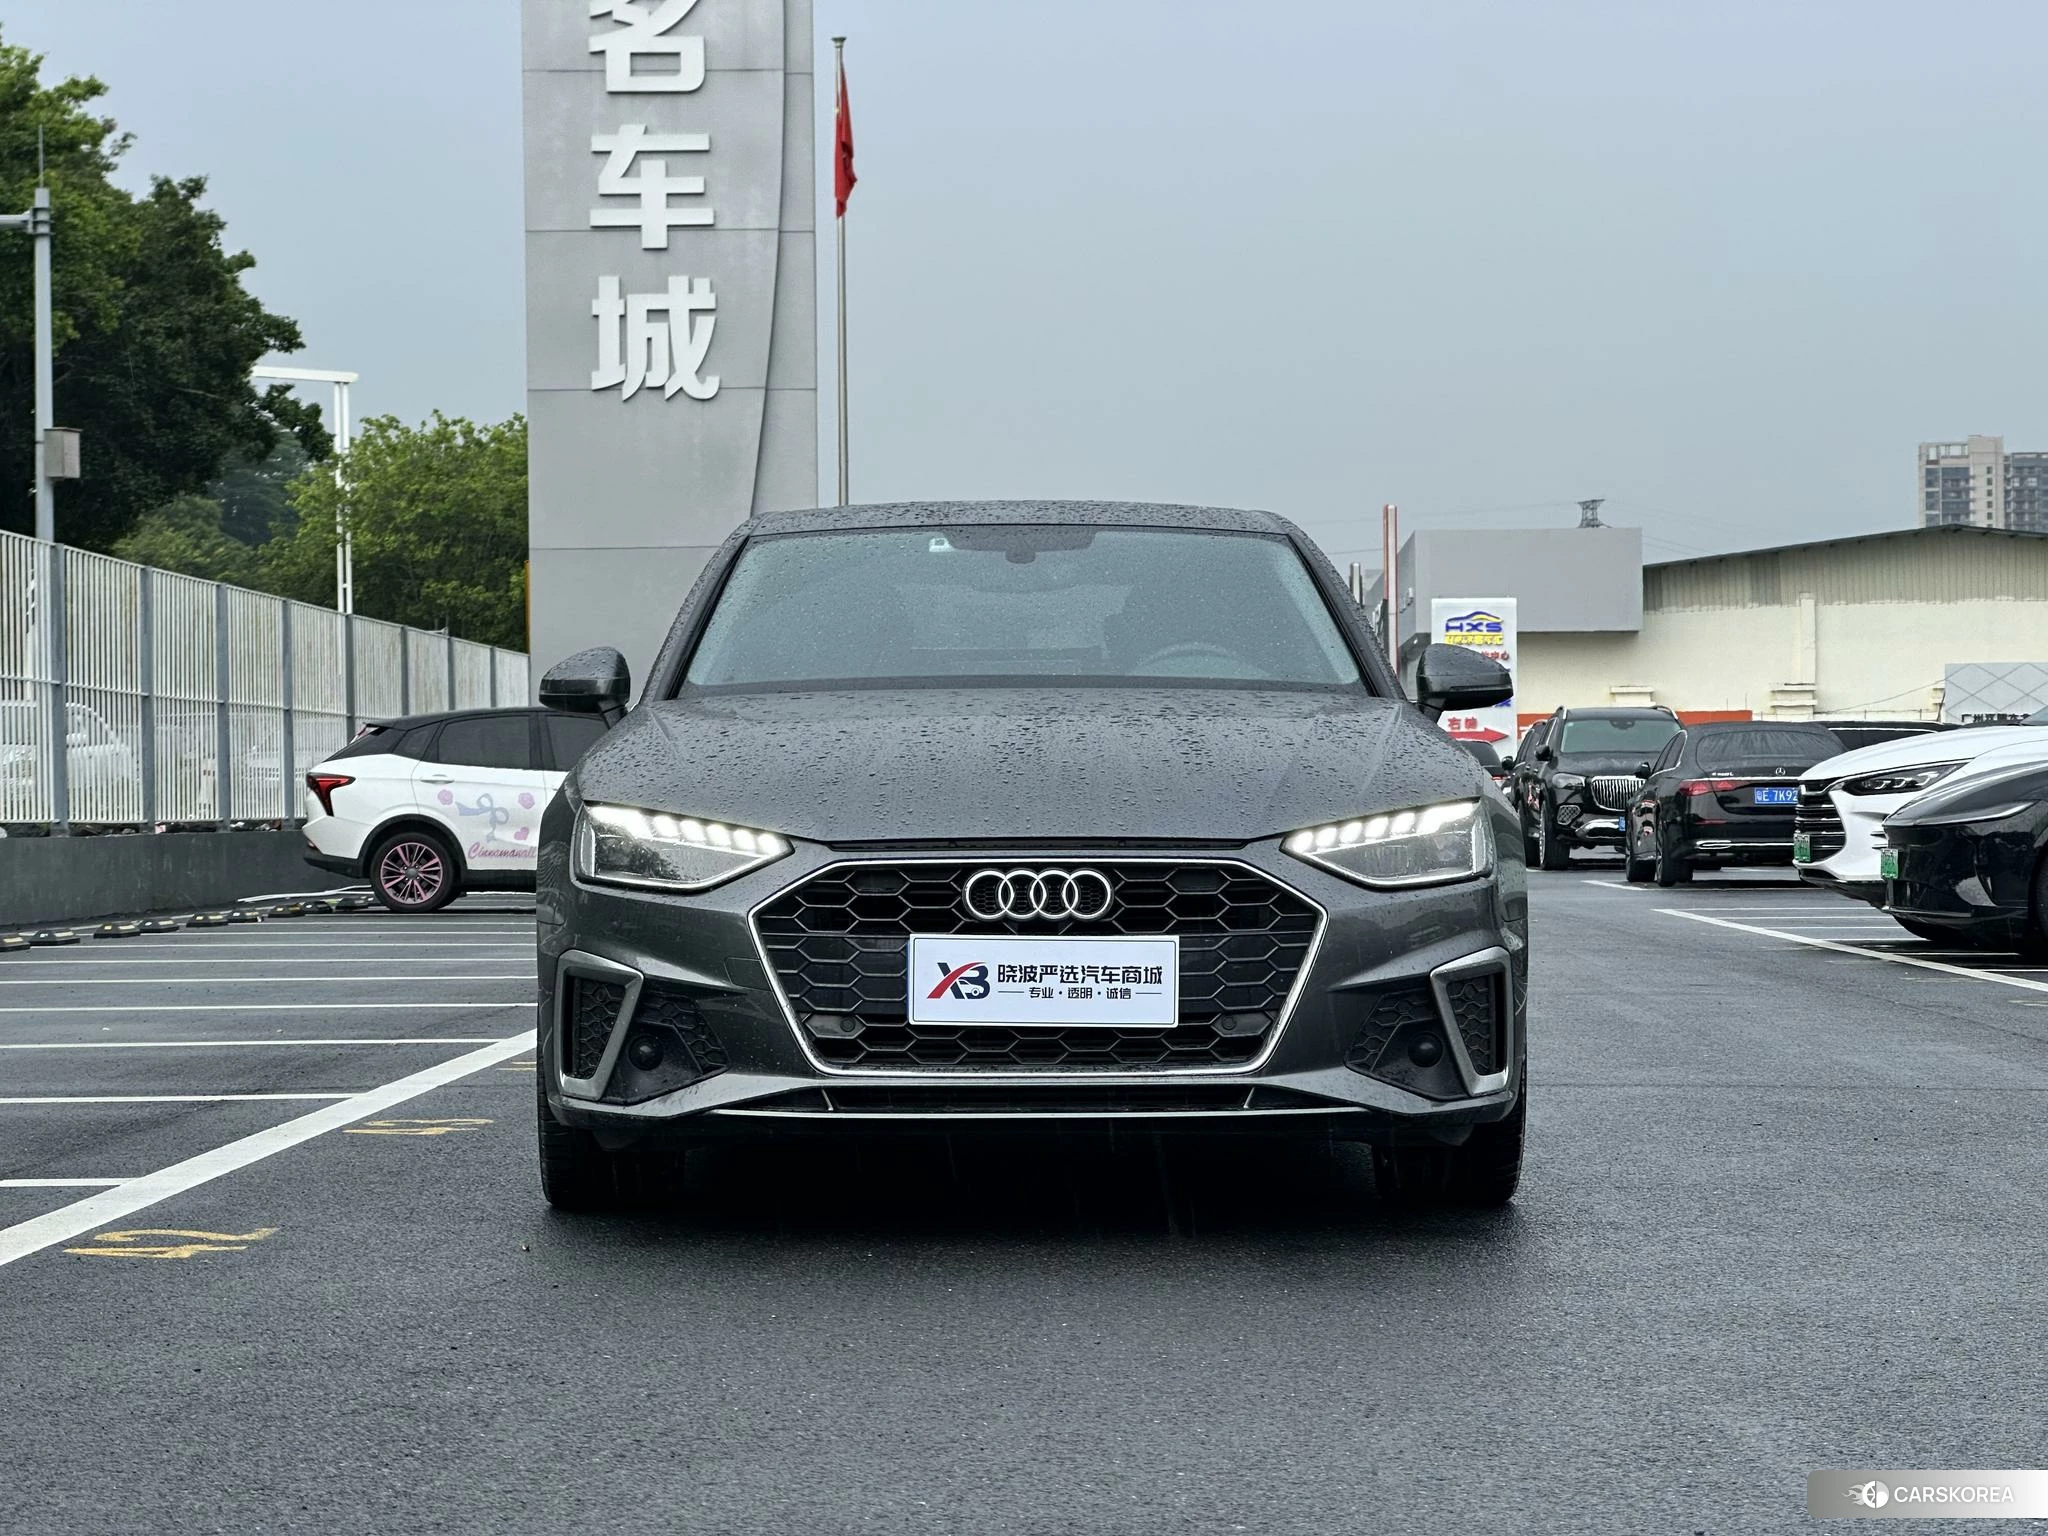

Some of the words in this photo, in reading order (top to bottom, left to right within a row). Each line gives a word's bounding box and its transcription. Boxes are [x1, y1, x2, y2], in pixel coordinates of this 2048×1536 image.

[997, 964, 1163, 985] 晓波严选汽车商城
